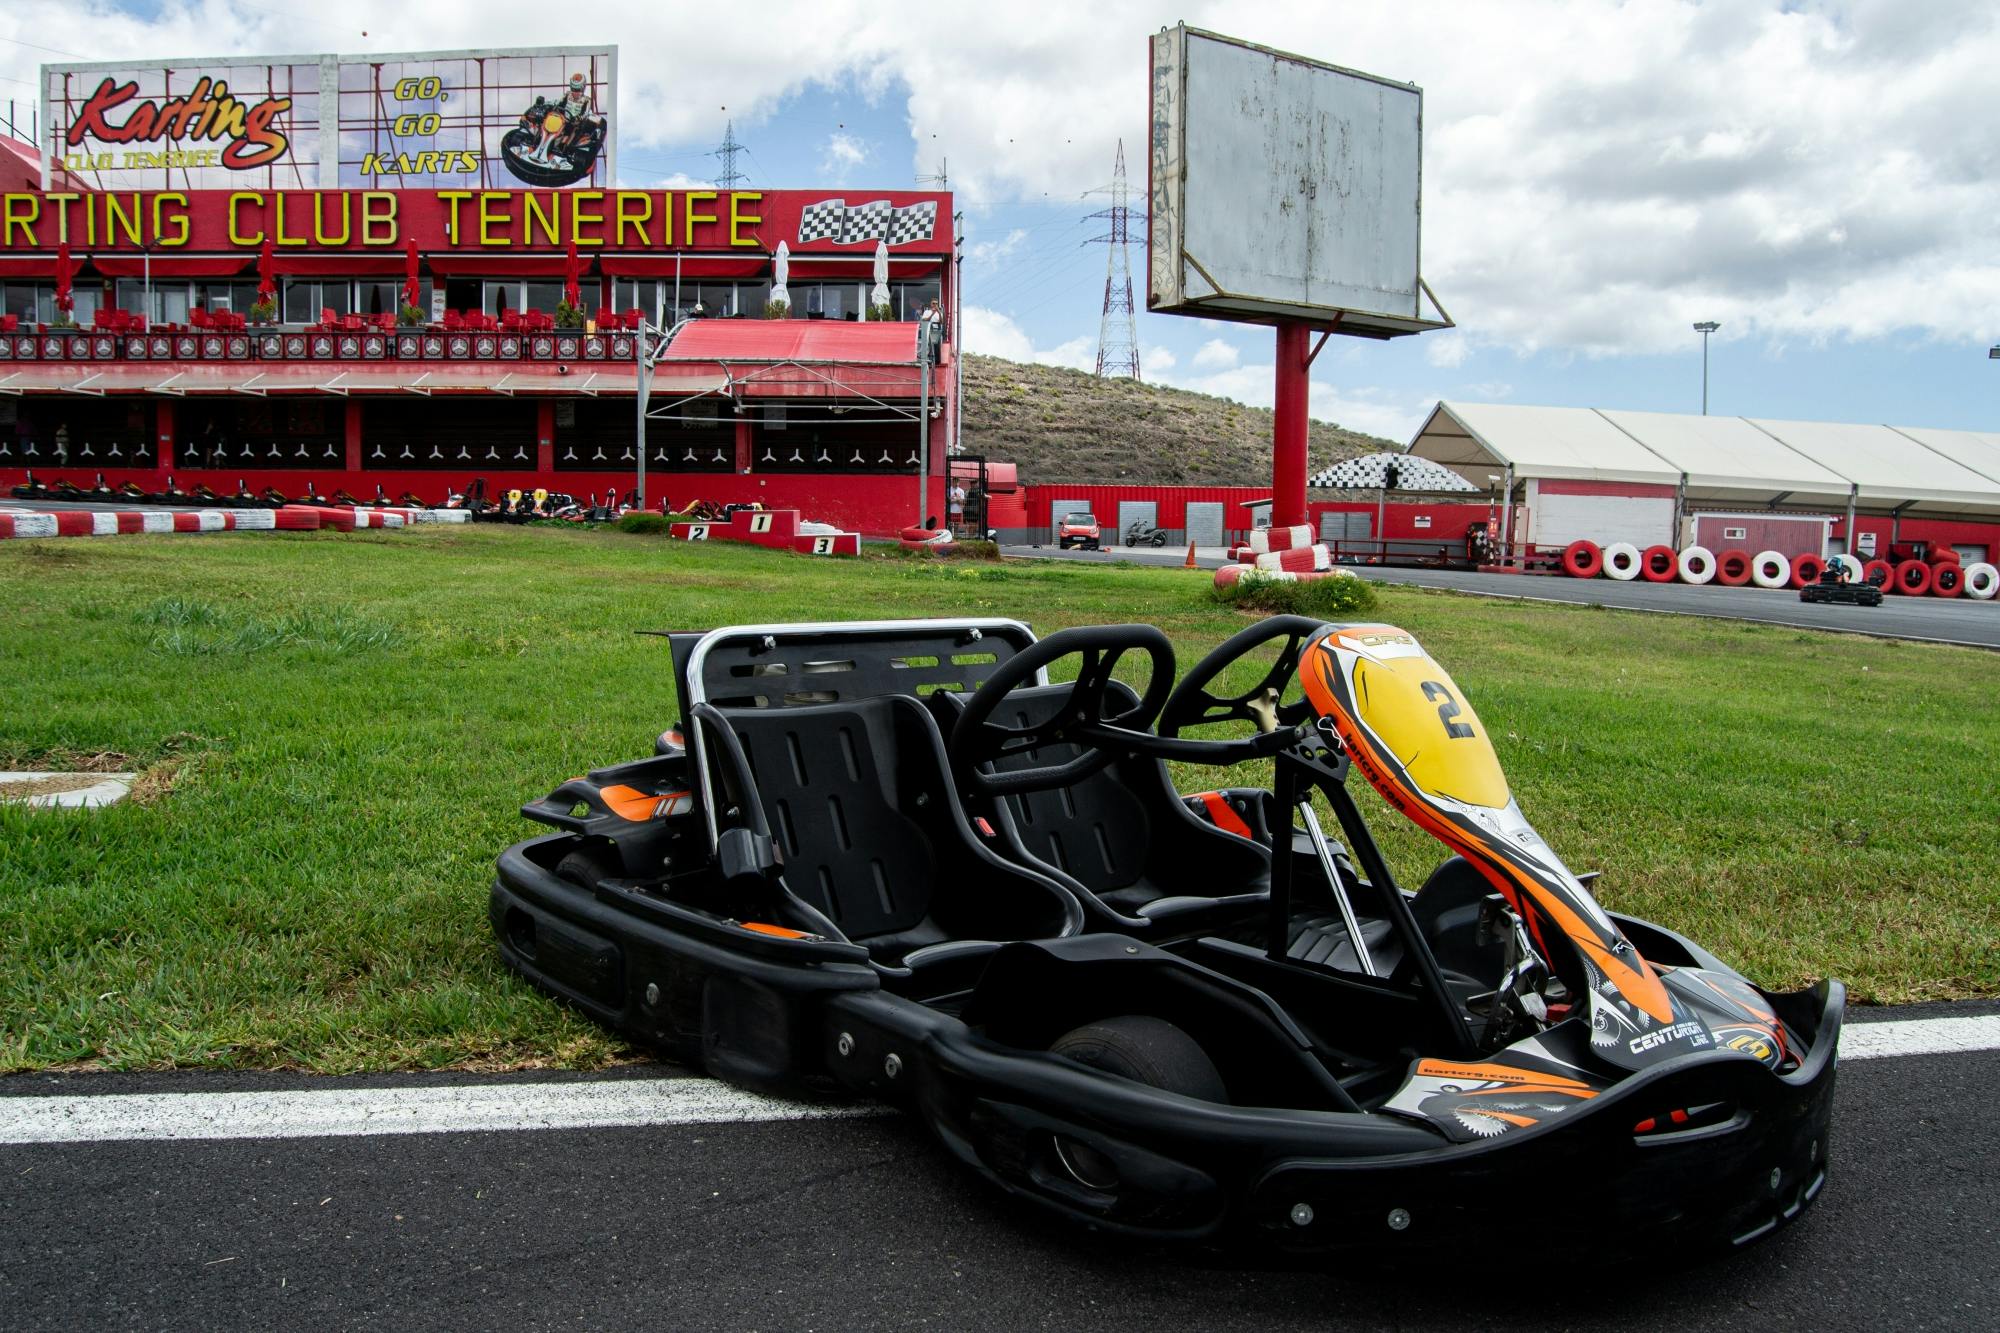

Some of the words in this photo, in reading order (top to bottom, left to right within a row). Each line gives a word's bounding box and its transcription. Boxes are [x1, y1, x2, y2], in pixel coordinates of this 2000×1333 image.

[394, 76, 449, 102] GO,
[67, 76, 292, 170] Karting
[394, 113, 441, 137] GO
[64, 152, 114, 171] CLUB
[122, 149, 219, 169] TENERIFE
[360, 150, 482, 175] KARTS
[4, 193, 190, 246] RTING
[229, 191, 398, 246] CLUB
[436, 191, 763, 246] TENERIFE
[692, 527, 704, 540] 2
[756, 516, 766, 530] 1
[818, 539, 829, 553] 3
[1420, 681, 1475, 738] 2
[1345, 733, 1406, 812] kartcrg.com
[1629, 1021, 1703, 1054] CENTURION
[1690, 1034, 1709, 1047] LINE
[1423, 1067, 1525, 1081] kartcrg.com
